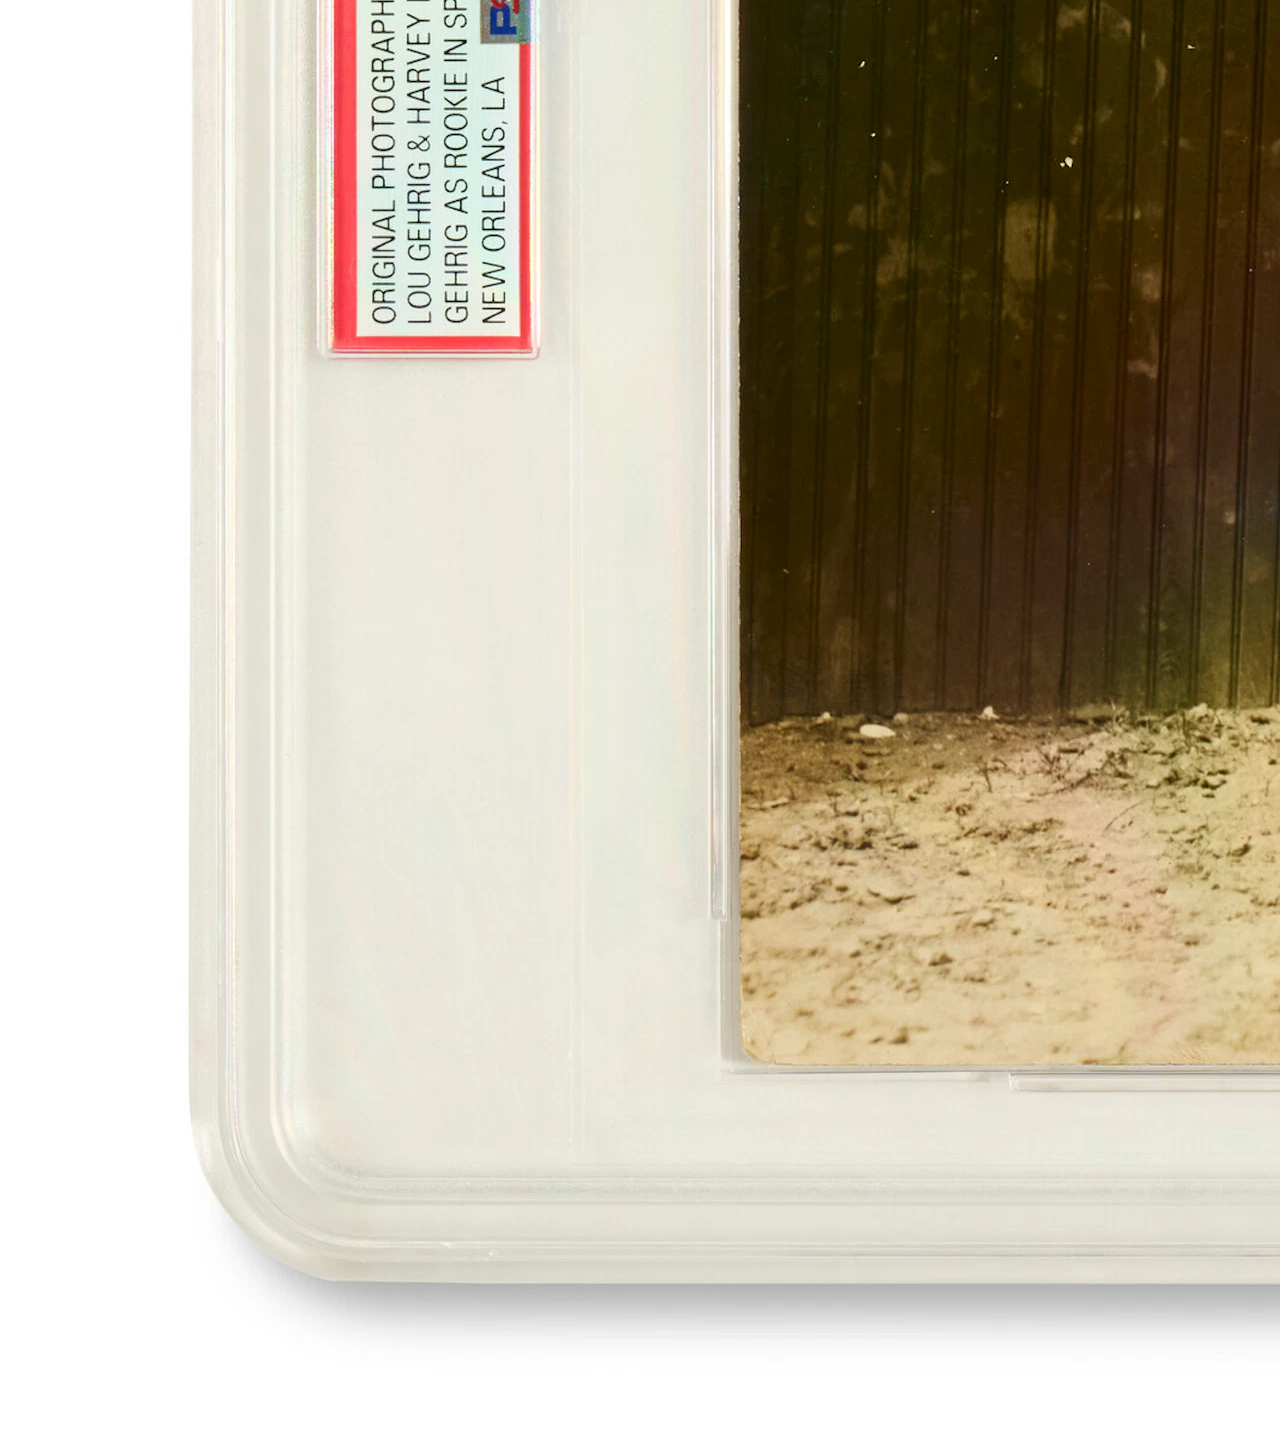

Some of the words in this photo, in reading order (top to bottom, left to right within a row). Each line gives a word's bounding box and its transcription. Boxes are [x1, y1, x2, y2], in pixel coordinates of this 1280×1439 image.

[370, 0, 396, 189] PHOTOGRAPH
[406, 14, 431, 124] HARVEY
[443, 39, 468, 62] IN
[480, 76, 506, 110] LA
[406, 135, 431, 152] &
[443, 73, 469, 169] ROOKIE
[406, 163, 432, 262] GEHRIG
[443, 178, 469, 215] AS
[481, 121, 508, 252] ORLEANS,
[371, 200, 397, 325] ORIGINAL
[407, 273, 432, 324] LOU
[444, 225, 469, 324] GEHRIG
[481, 262, 506, 324] NEW
